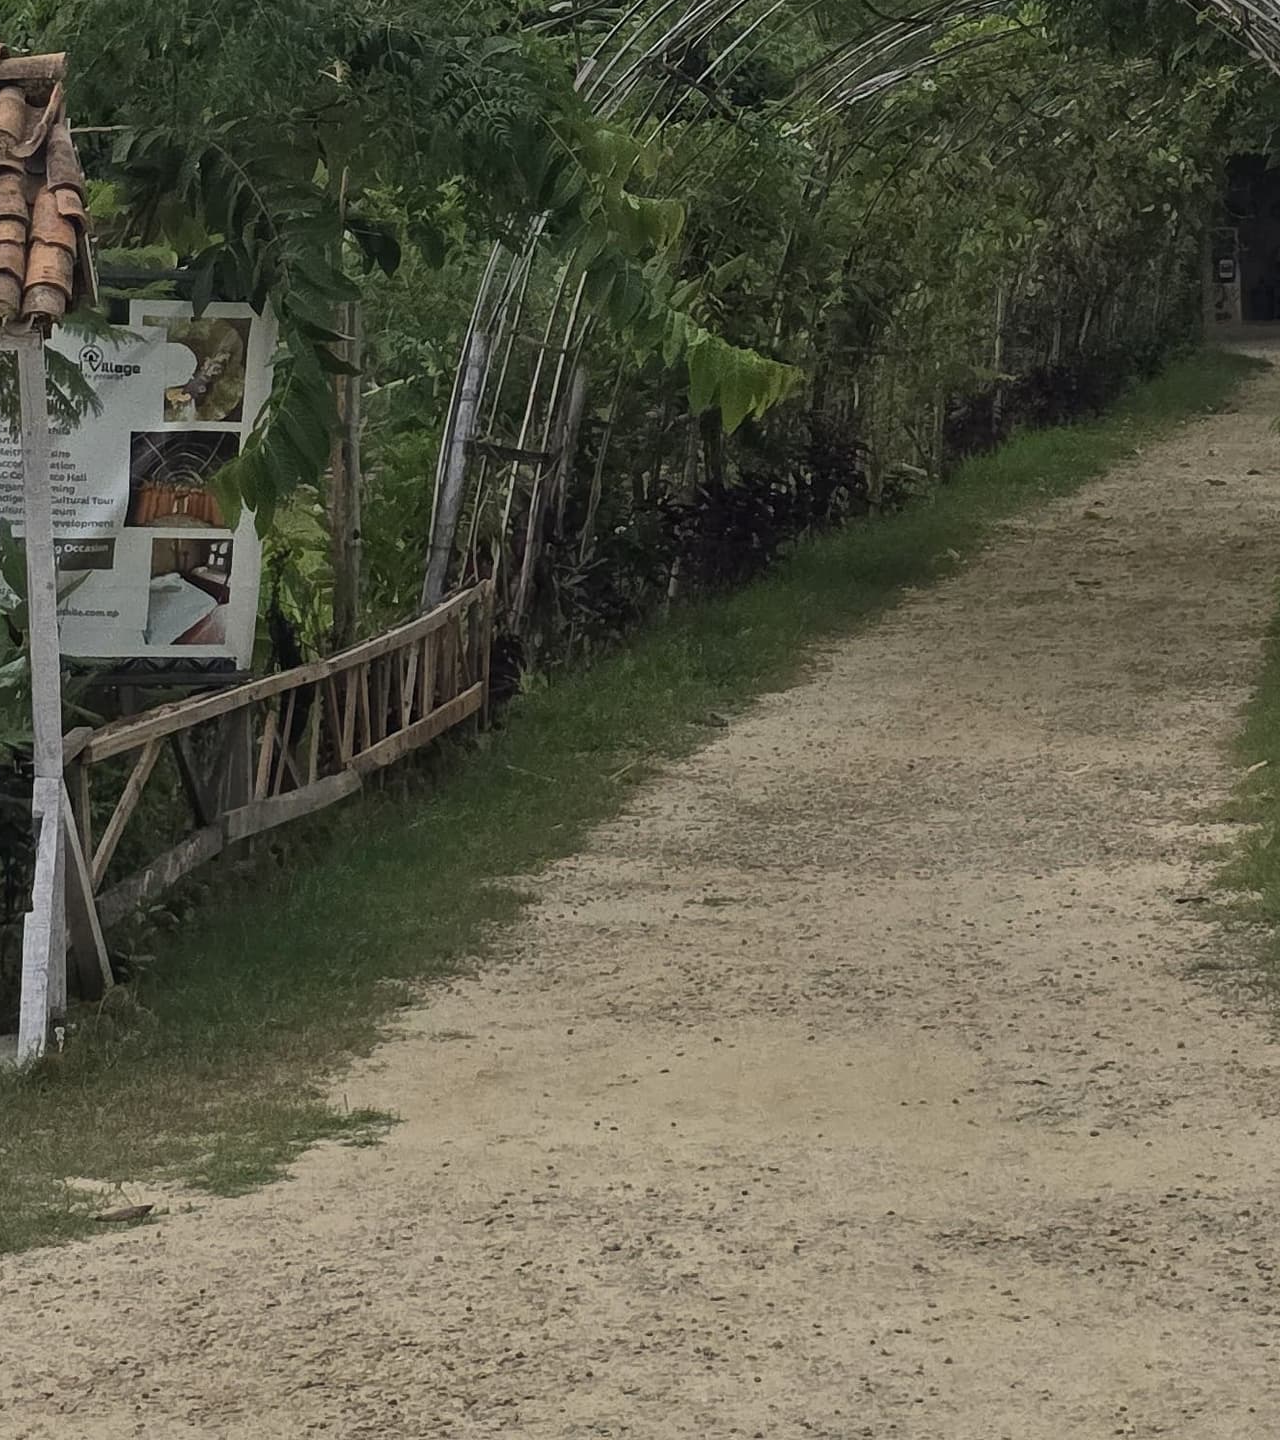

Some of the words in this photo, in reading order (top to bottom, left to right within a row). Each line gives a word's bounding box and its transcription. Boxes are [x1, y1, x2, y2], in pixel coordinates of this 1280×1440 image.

[89, 360, 141, 376] Village
[67, 473, 87, 481] Hall
[52, 520, 114, 529] evelopment
